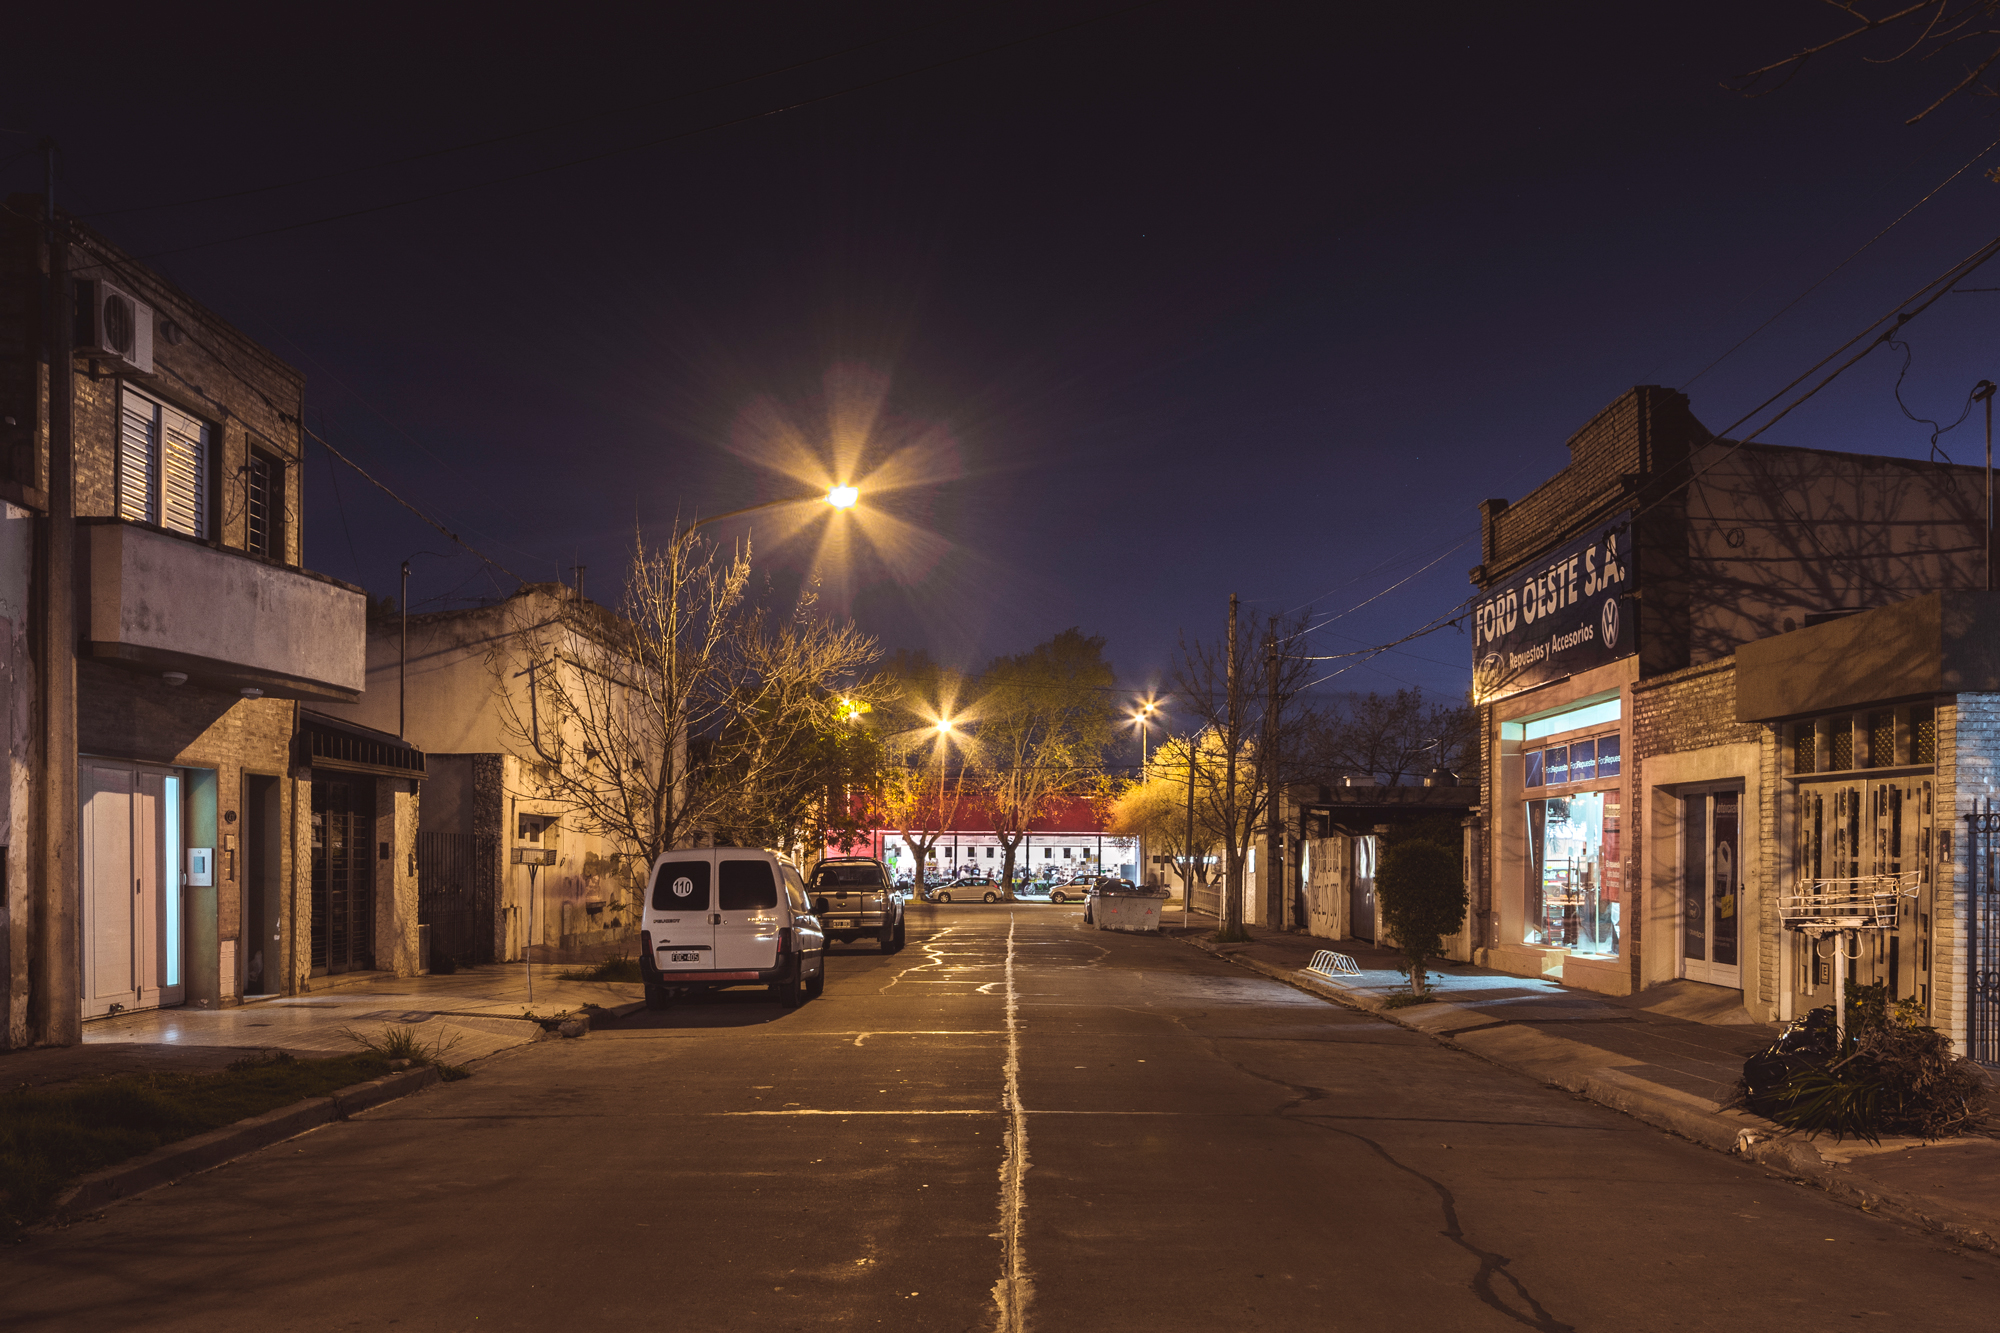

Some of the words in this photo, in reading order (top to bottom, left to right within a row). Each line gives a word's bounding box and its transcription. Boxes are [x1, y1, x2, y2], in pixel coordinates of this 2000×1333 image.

[1476, 588, 1518, 646] FORD
[1523, 553, 1578, 624] OESTE
[1584, 533, 1625, 597] S.A.
[1509, 644, 1544, 672] Repuestos
[1545, 642, 1550, 661] y
[1551, 622, 1594, 654] Accesorios
[674, 881, 691, 894] 110
